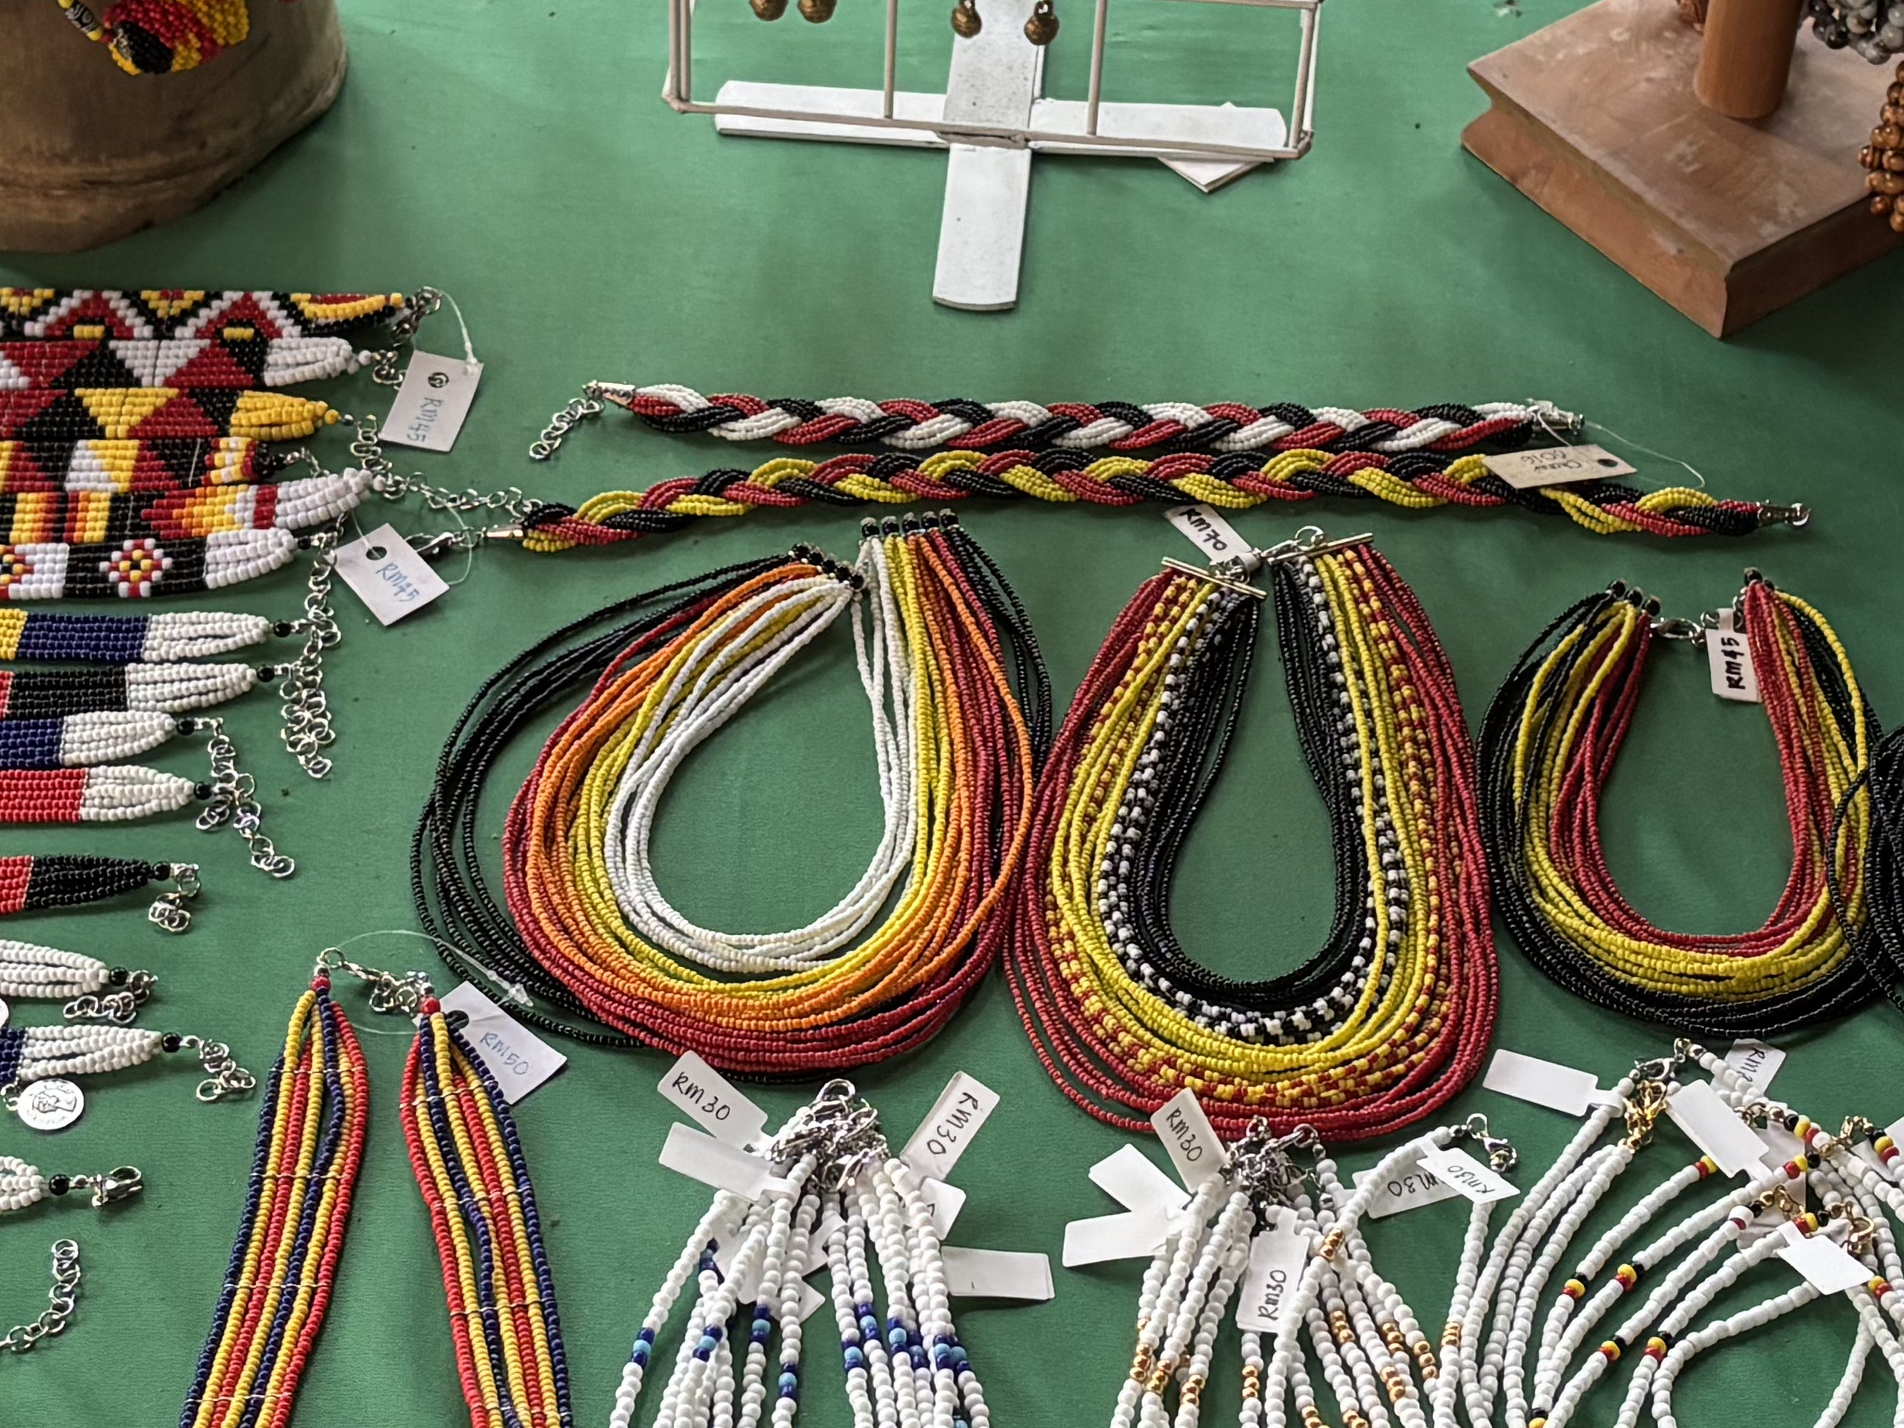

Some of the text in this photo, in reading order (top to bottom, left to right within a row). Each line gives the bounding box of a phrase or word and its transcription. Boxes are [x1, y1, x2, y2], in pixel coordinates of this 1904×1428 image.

[407, 396, 443, 444] RM45
[1179, 508, 1228, 551] RM70
[375, 562, 421, 603] RM45
[1721, 637, 1746, 690] RM45
[479, 1032, 530, 1076] RM50
[672, 1071, 731, 1121] RM30
[926, 1091, 979, 1156] RM30
[1166, 1107, 1202, 1162] RM30
[1448, 1165, 1496, 1194] RM30
[1257, 1269, 1287, 1322] RM30
